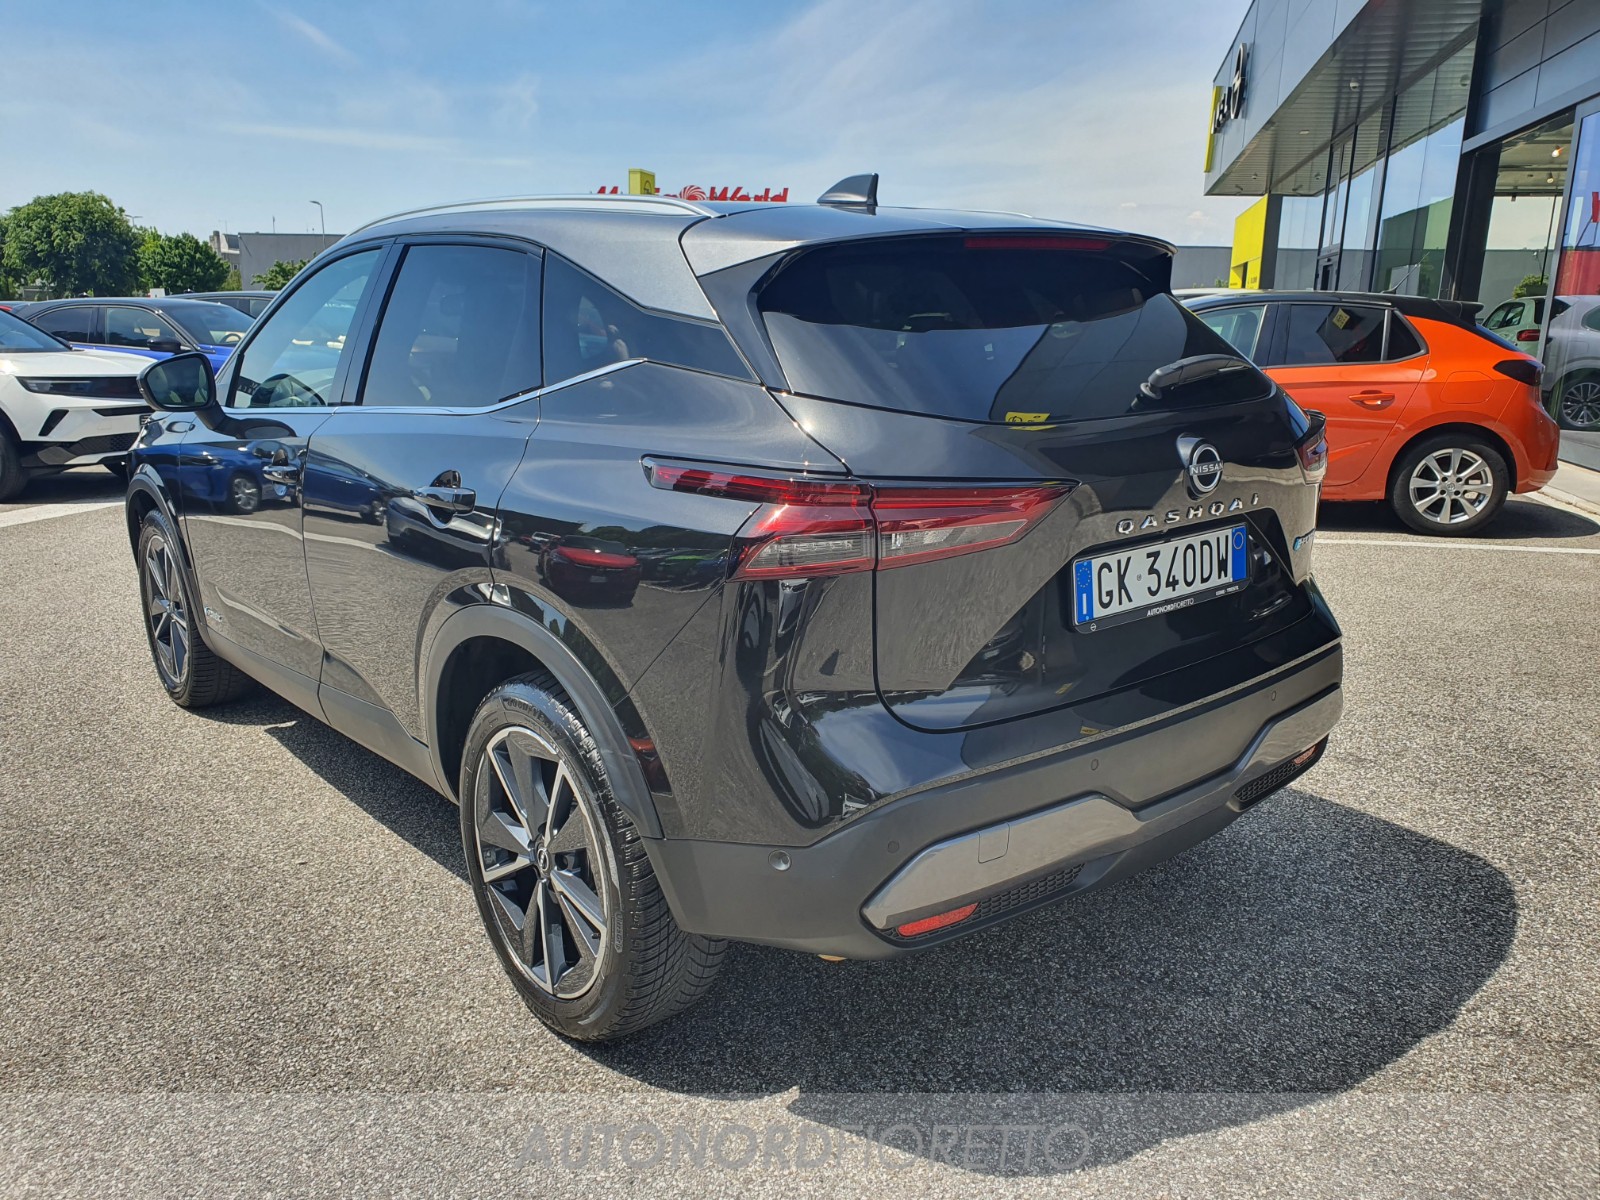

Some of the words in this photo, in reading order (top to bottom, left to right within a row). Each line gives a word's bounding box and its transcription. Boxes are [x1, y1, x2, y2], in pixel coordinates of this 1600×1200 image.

[1191, 461, 1223, 474] NISSAN
[1118, 493, 1259, 534] QASHQAI
[1097, 556, 1133, 609] GK
[1146, 535, 1229, 597] 340DW
